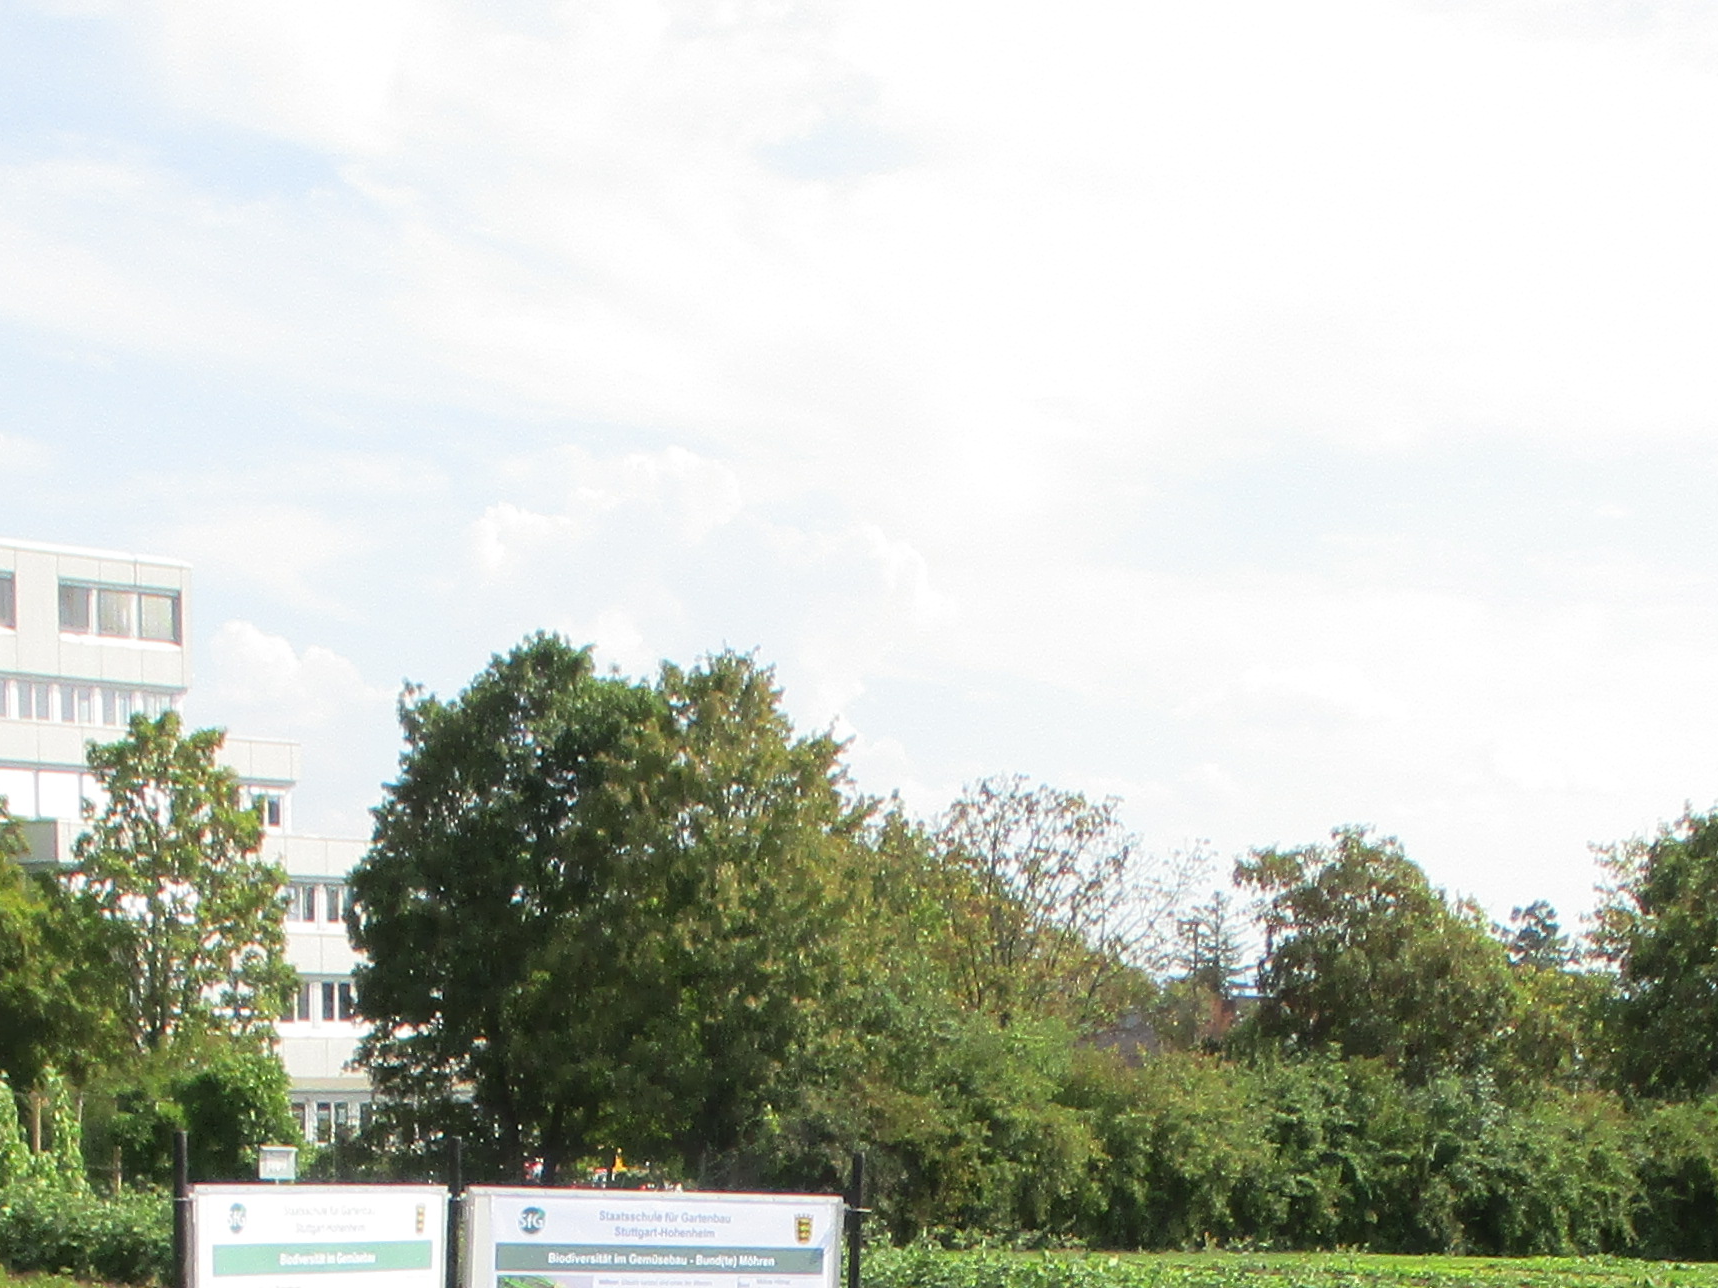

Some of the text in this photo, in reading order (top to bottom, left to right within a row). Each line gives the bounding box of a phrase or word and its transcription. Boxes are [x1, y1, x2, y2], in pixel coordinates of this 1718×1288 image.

[519, 1212, 544, 1229] SfG
[599, 1210, 731, 1224] Staatsschule für Gartenbau
[614, 1226, 715, 1239] Stuttgart-Hohenheim
[548, 1252, 612, 1265] Biodiversität
[614, 1254, 627, 1265] im
[629, 1253, 688, 1266] Gemüsebau
[696, 1255, 737, 1268] Bund(te)
[739, 1255, 775, 1267] Möhren
